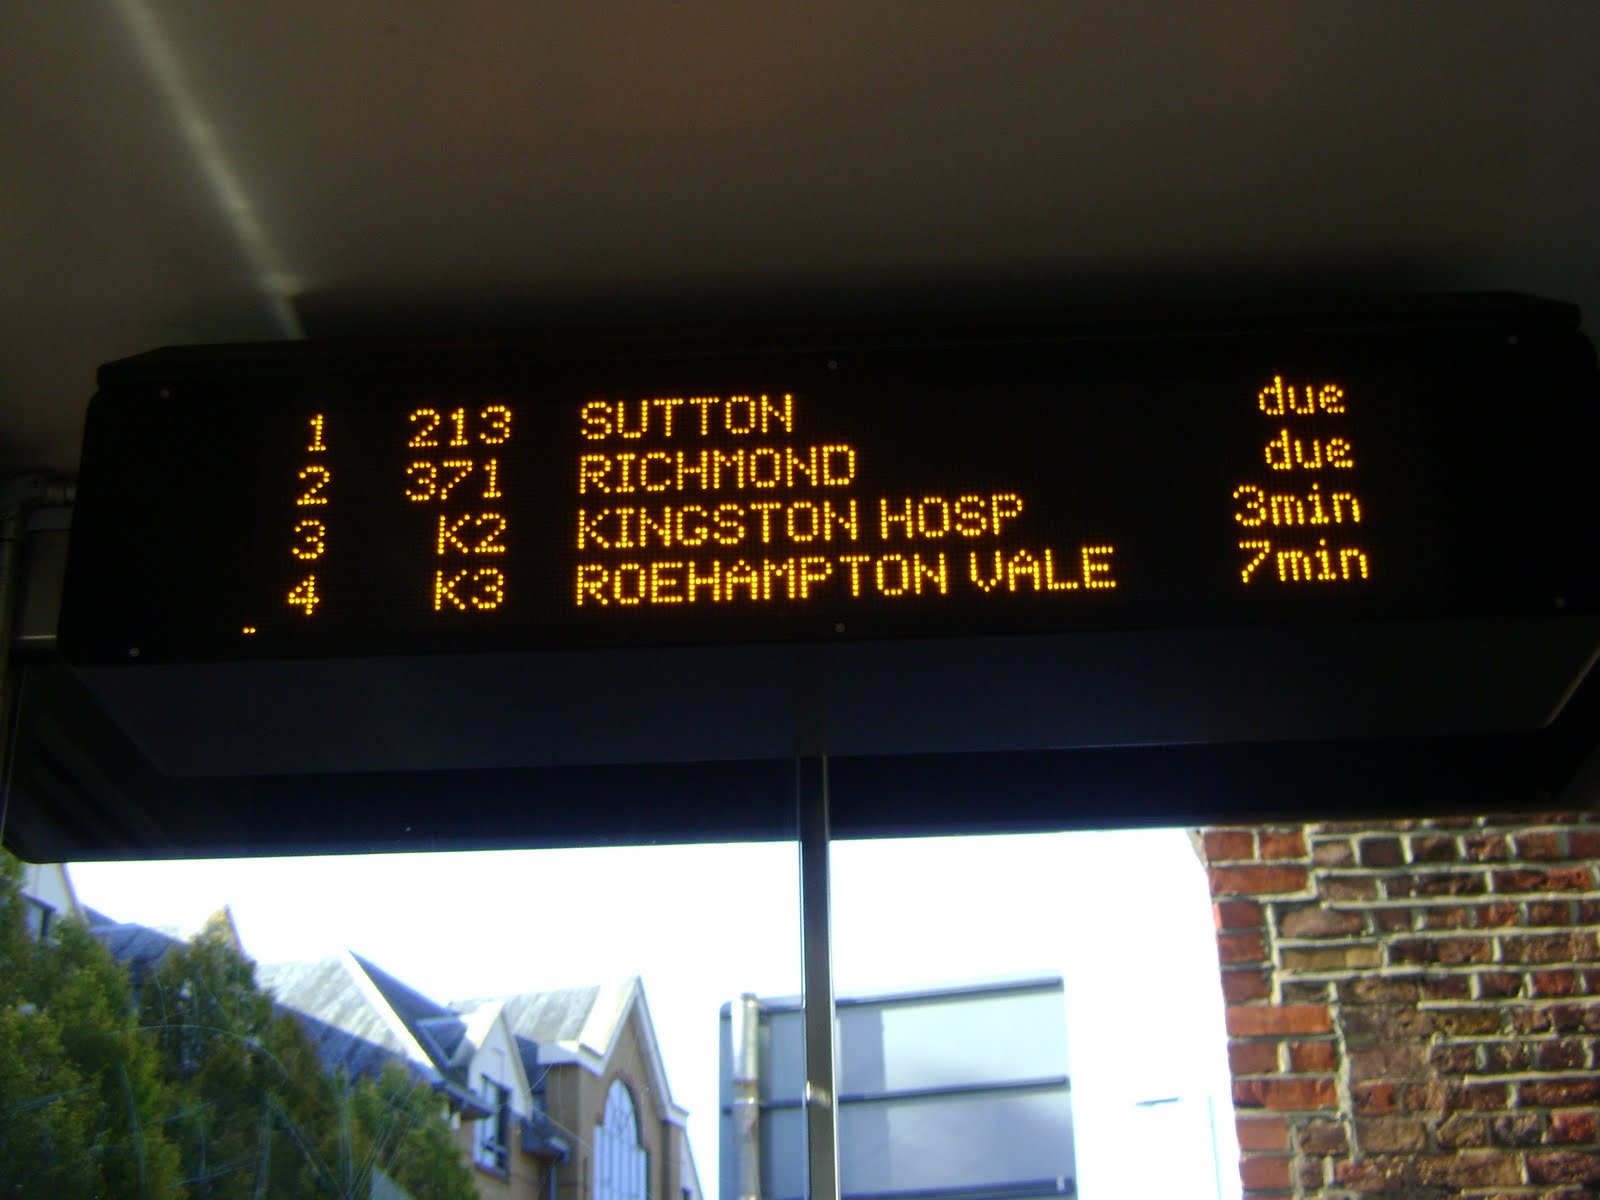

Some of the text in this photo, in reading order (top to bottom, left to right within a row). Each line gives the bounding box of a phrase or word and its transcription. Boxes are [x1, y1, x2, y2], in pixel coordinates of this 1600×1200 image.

[308, 375, 1346, 452] 1 213 SUTTON due
[296, 428, 1354, 506] 2 371 RICHMOND due
[291, 482, 1361, 560] 3 K2 KINGSTON HOSP 3min
[287, 538, 1369, 616] 4 K3 ROEHAMPTON VALE 7min
